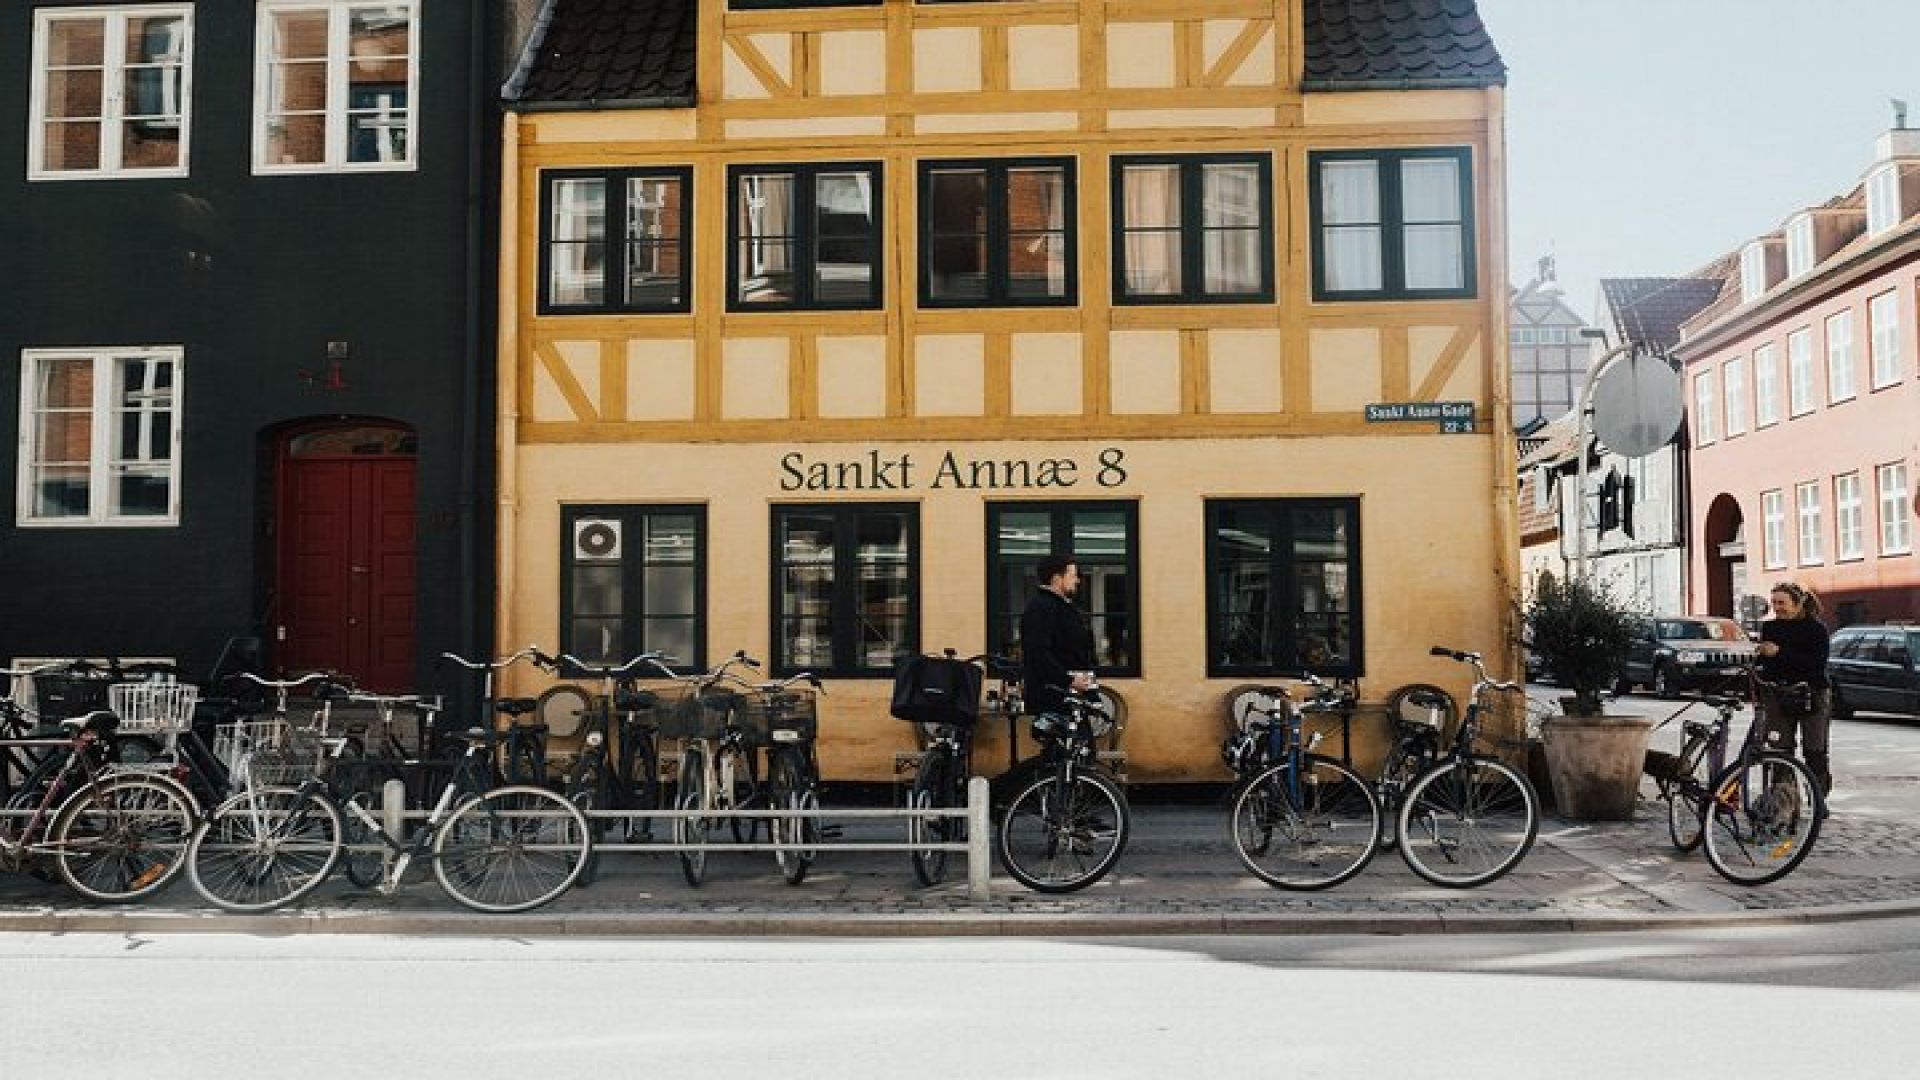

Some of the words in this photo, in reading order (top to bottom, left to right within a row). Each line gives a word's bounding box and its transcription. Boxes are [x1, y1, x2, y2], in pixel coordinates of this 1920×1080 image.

[1442, 403, 1473, 417] Gade
[780, 449, 915, 491] Sankt
[930, 449, 1078, 489] Annæ
[1096, 447, 1128, 488] 8
